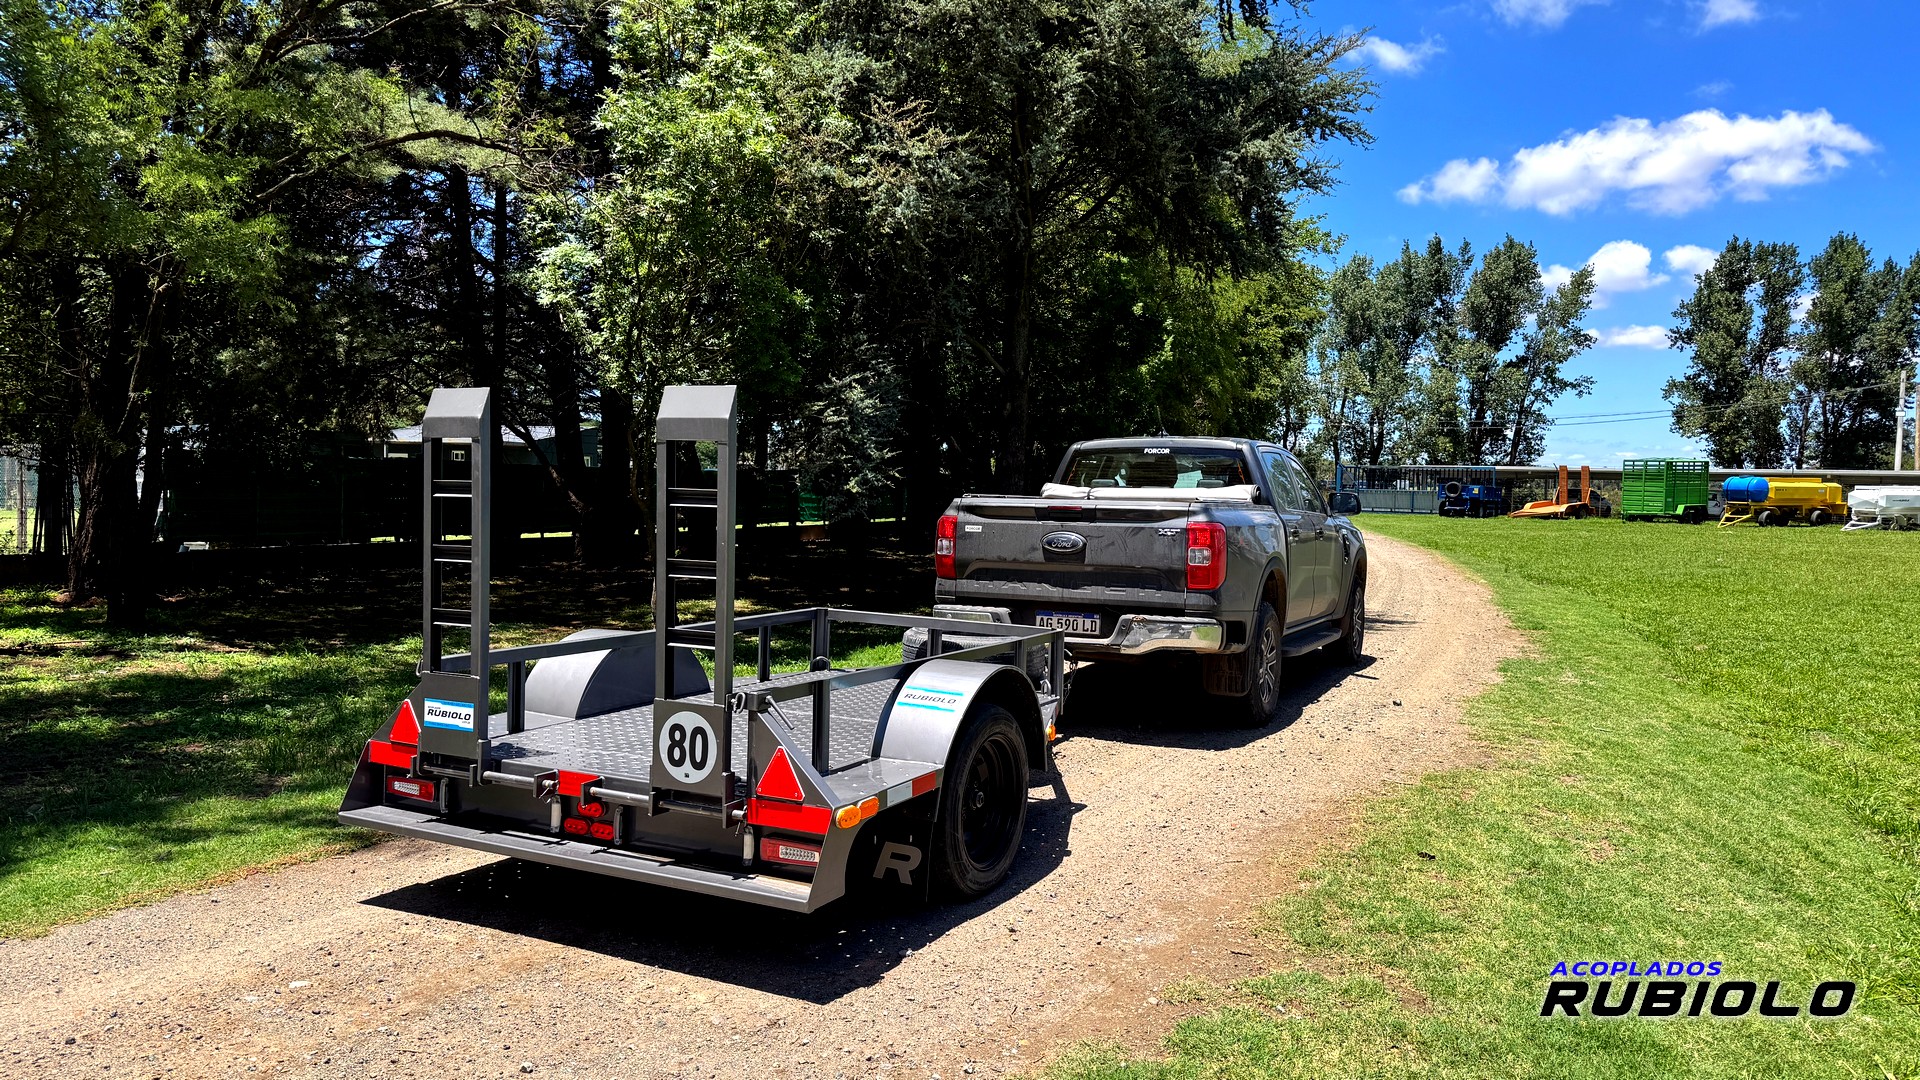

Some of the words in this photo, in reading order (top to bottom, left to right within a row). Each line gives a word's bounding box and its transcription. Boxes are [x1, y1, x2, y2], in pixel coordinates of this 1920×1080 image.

[1051, 537, 1073, 548] Ford
[1039, 617, 1053, 627] AG
[1056, 618, 1078, 631] 590
[1082, 620, 1097, 632] LD
[904, 694, 957, 704] RUBIOLO
[427, 709, 471, 720] RUBIOLO
[667, 723, 709, 771] 80
[873, 841, 922, 885] R
